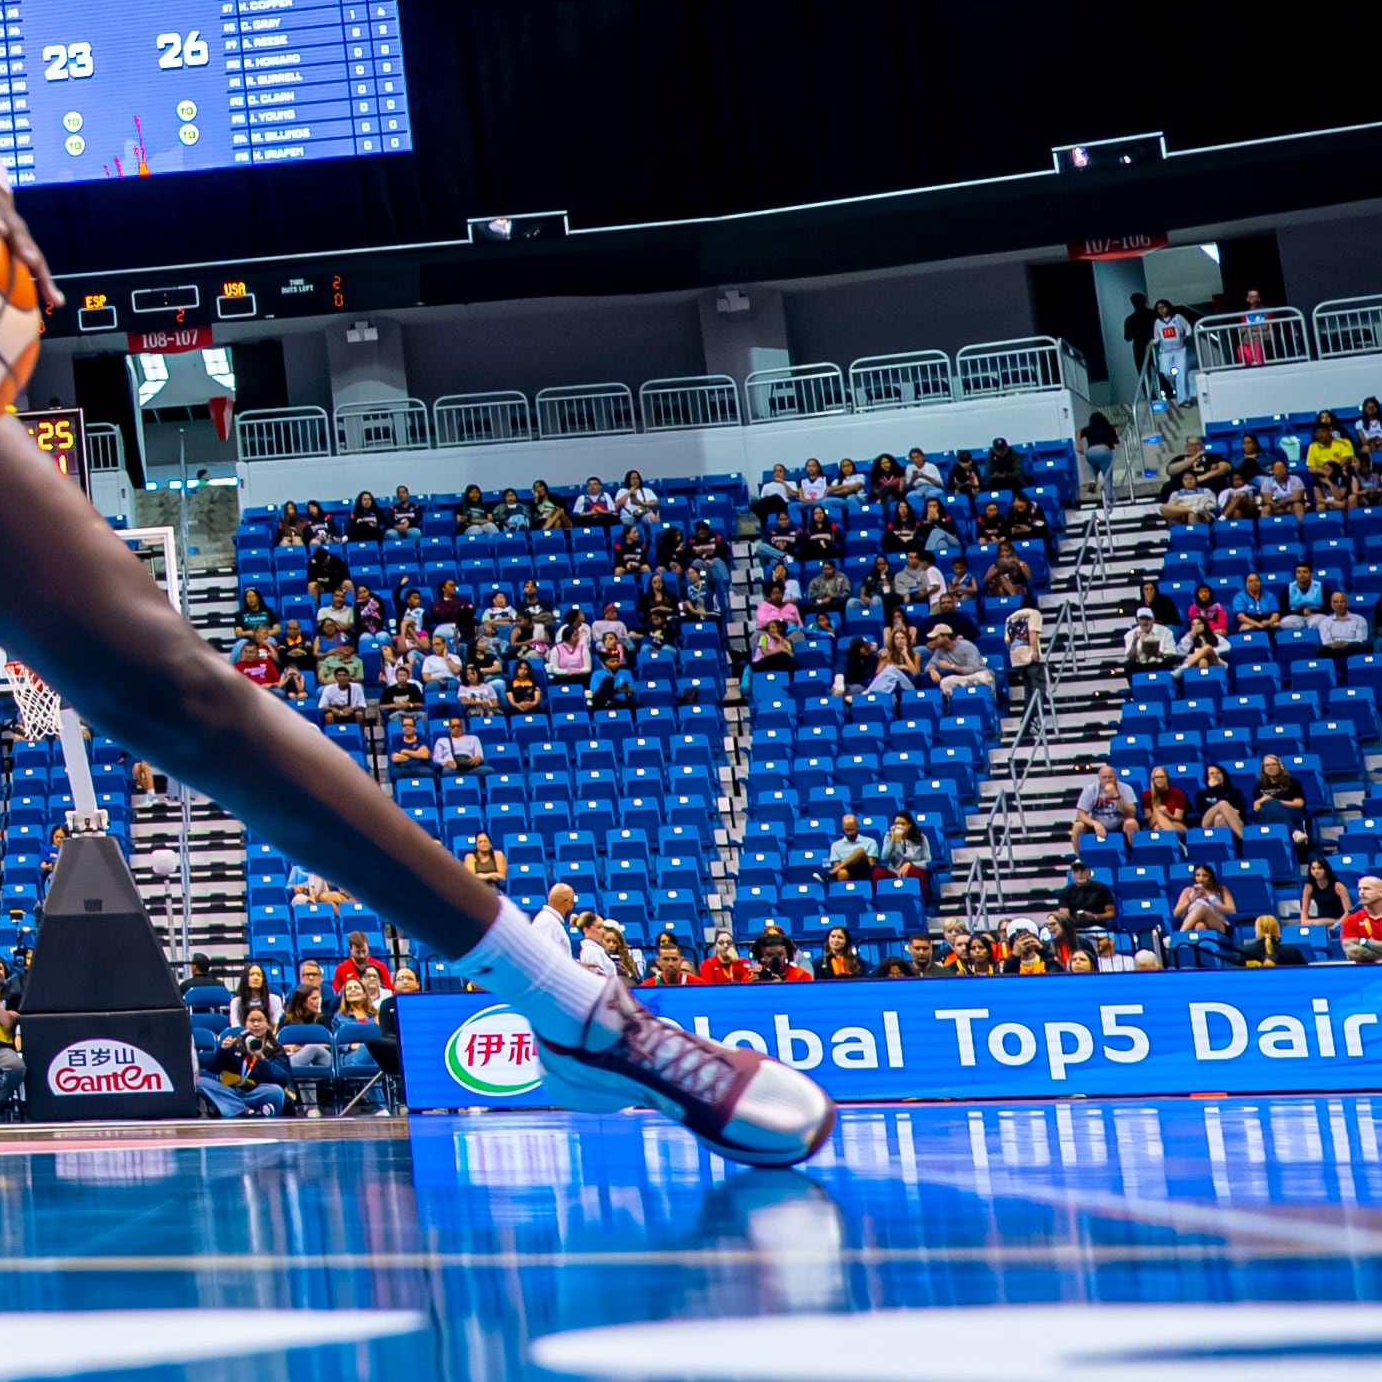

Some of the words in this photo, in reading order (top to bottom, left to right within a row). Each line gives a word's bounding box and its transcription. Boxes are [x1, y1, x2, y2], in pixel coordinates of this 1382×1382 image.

[156, 30, 209, 69] 26
[42, 41, 94, 81] 23
[255, 53, 301, 67] HOWARD
[258, 109, 296, 122] YOUNG
[223, 281, 247, 297] USA
[298, 284, 314, 293] LEFT
[85, 295, 107, 309] ESP
[141, 329, 199, 349] 108-107
[37, 421, 74, 451] 25
[657, 1009, 905, 1071] lobal
[934, 1003, 1150, 1080] Top5
[1188, 998, 1379, 1061] Dair
[68, 1048, 135, 1067] 百岁山
